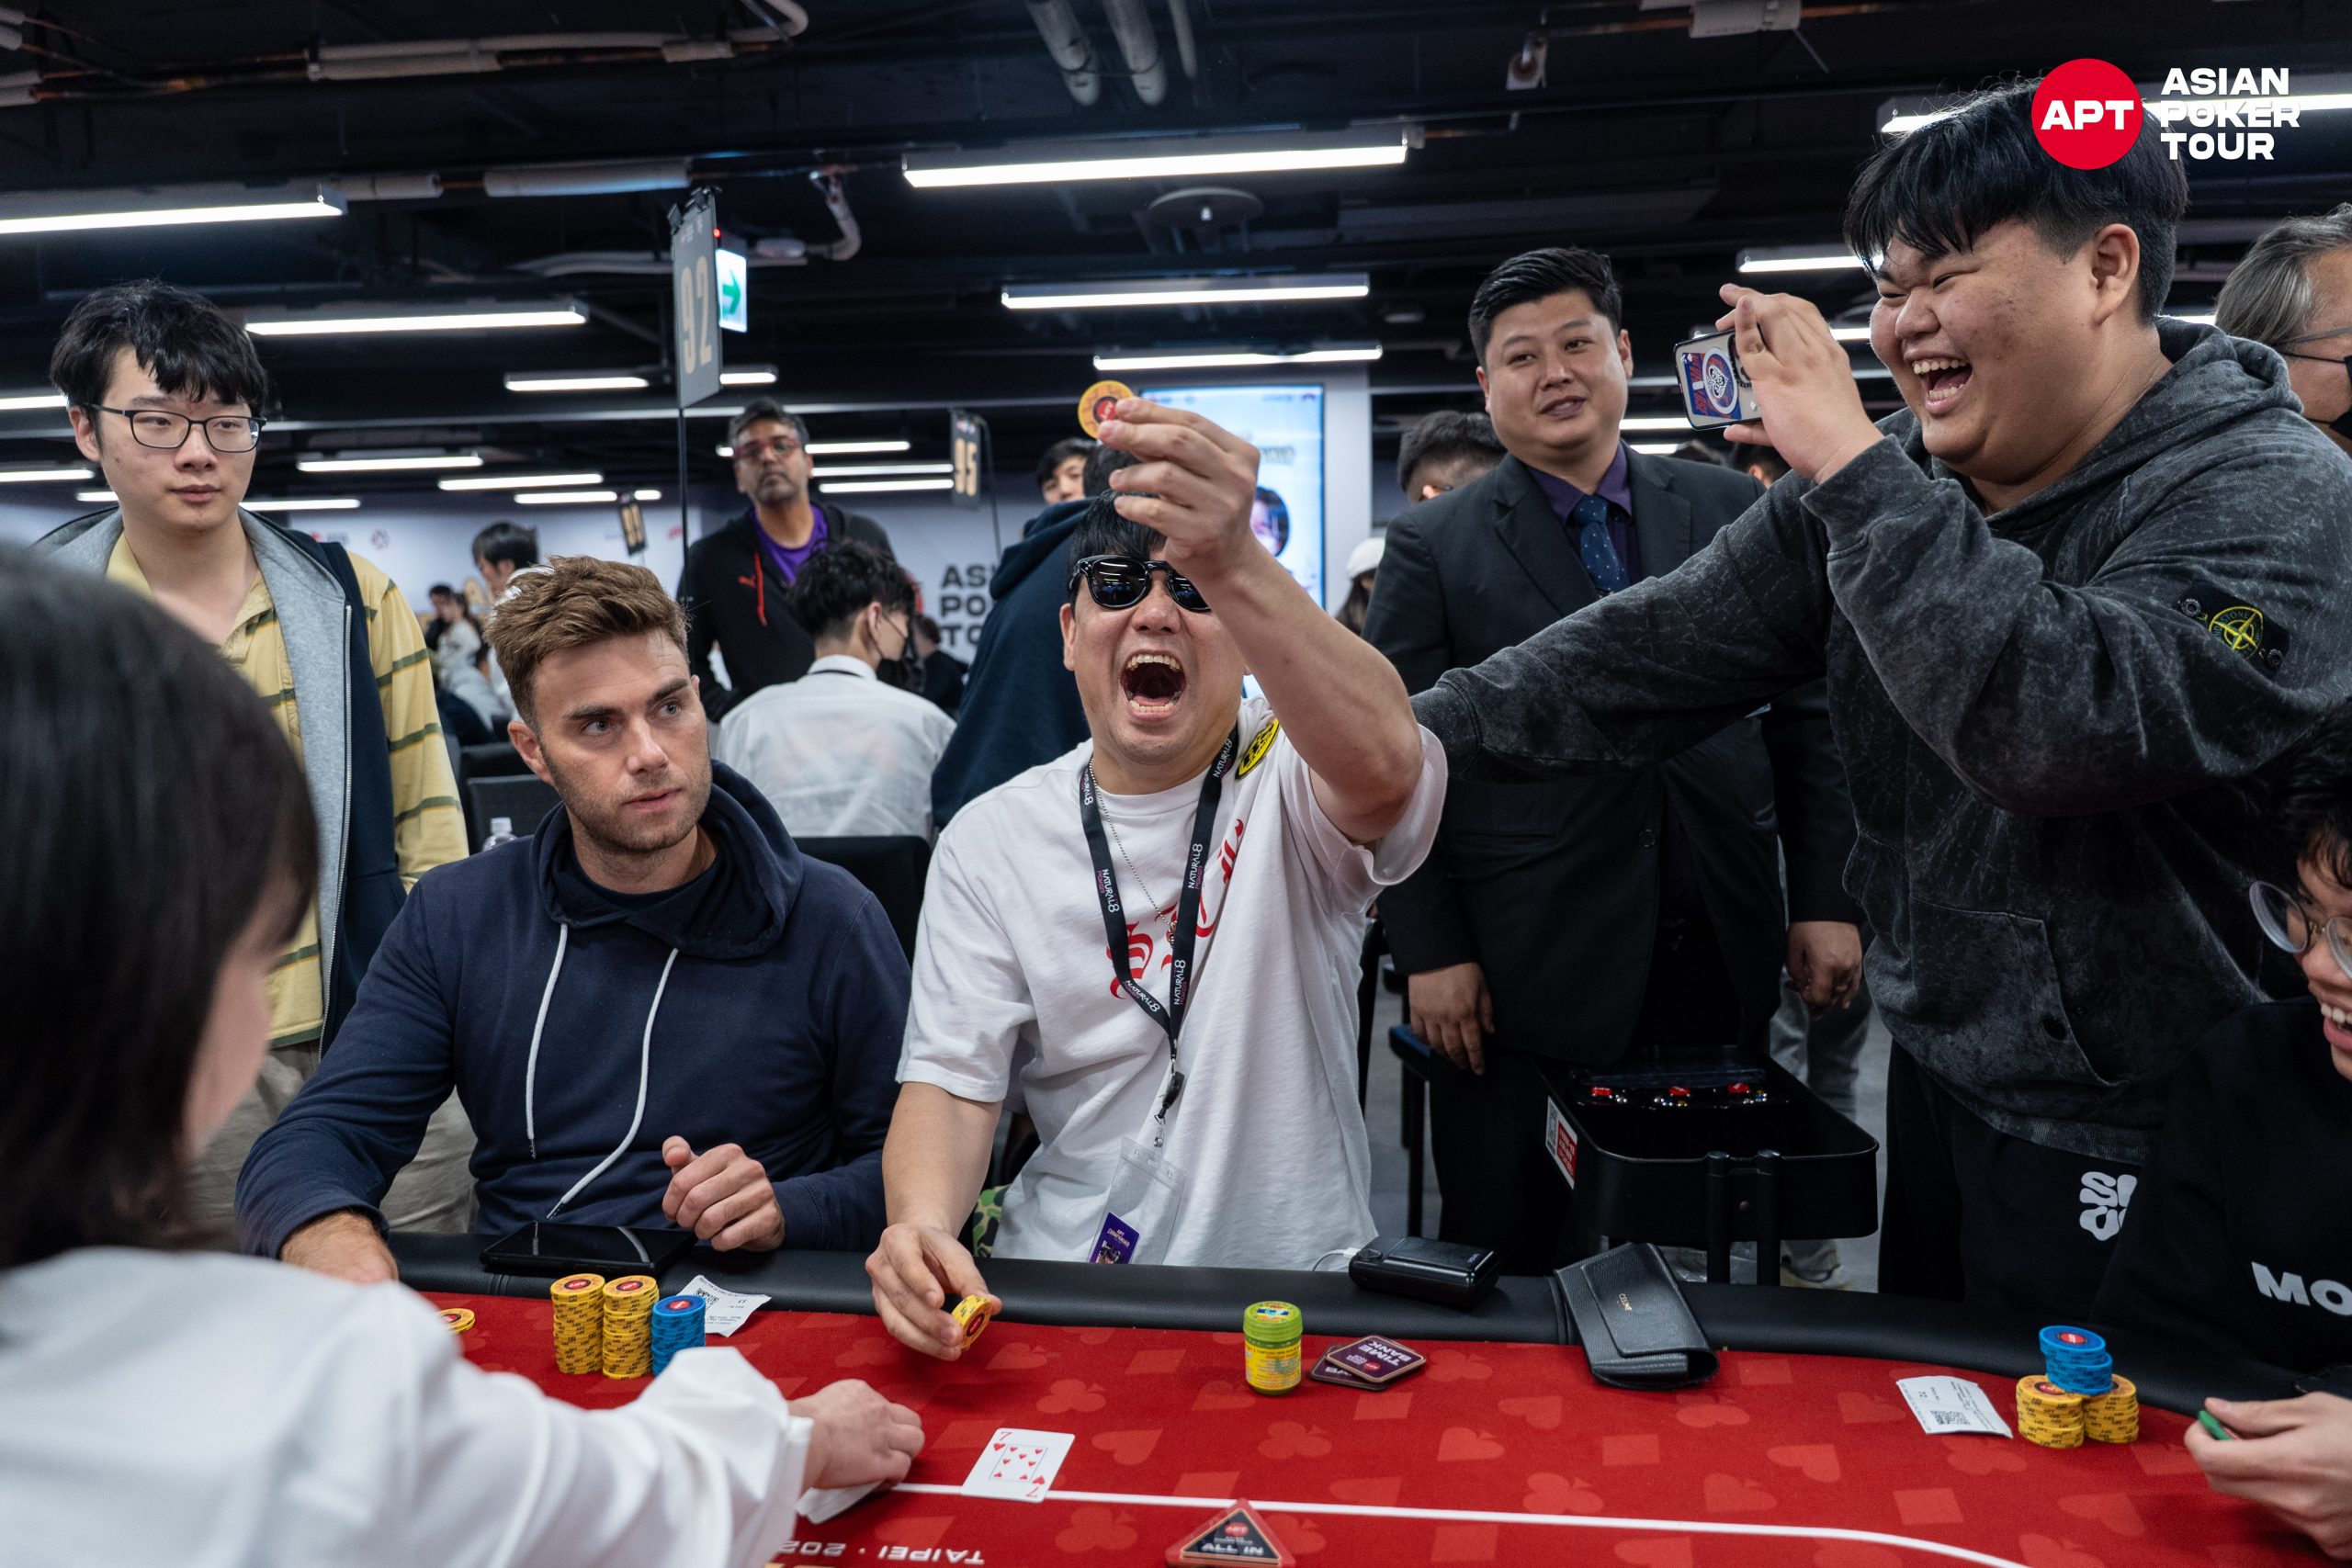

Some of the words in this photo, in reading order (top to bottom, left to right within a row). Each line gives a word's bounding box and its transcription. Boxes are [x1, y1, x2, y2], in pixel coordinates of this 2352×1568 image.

[680, 255, 713, 375] 92
[942, 595, 987, 617] PO
[2220, 611, 2250, 624] STONE
[1213, 739, 1233, 778] NATURAL8
[1188, 843, 1204, 889] NATURAL8
[1102, 869, 1120, 913] NATURAL8
[1174, 959, 1186, 1005] NATURAL8
[1125, 980, 1160, 1012] NATURAL8
[2251, 1261, 2352, 1316] MO
[1358, 1344, 1400, 1366] TIME
[1368, 1340, 1412, 1362] BANK
[1000, 1431, 1013, 1441] 7
[1025, 1486, 1040, 1498] 7
[782, 1540, 847, 1556] 202
[877, 1545, 986, 1565] TAIPEI
[1201, 1542, 1239, 1554] ALL
[1243, 1546, 1264, 1556] IN
